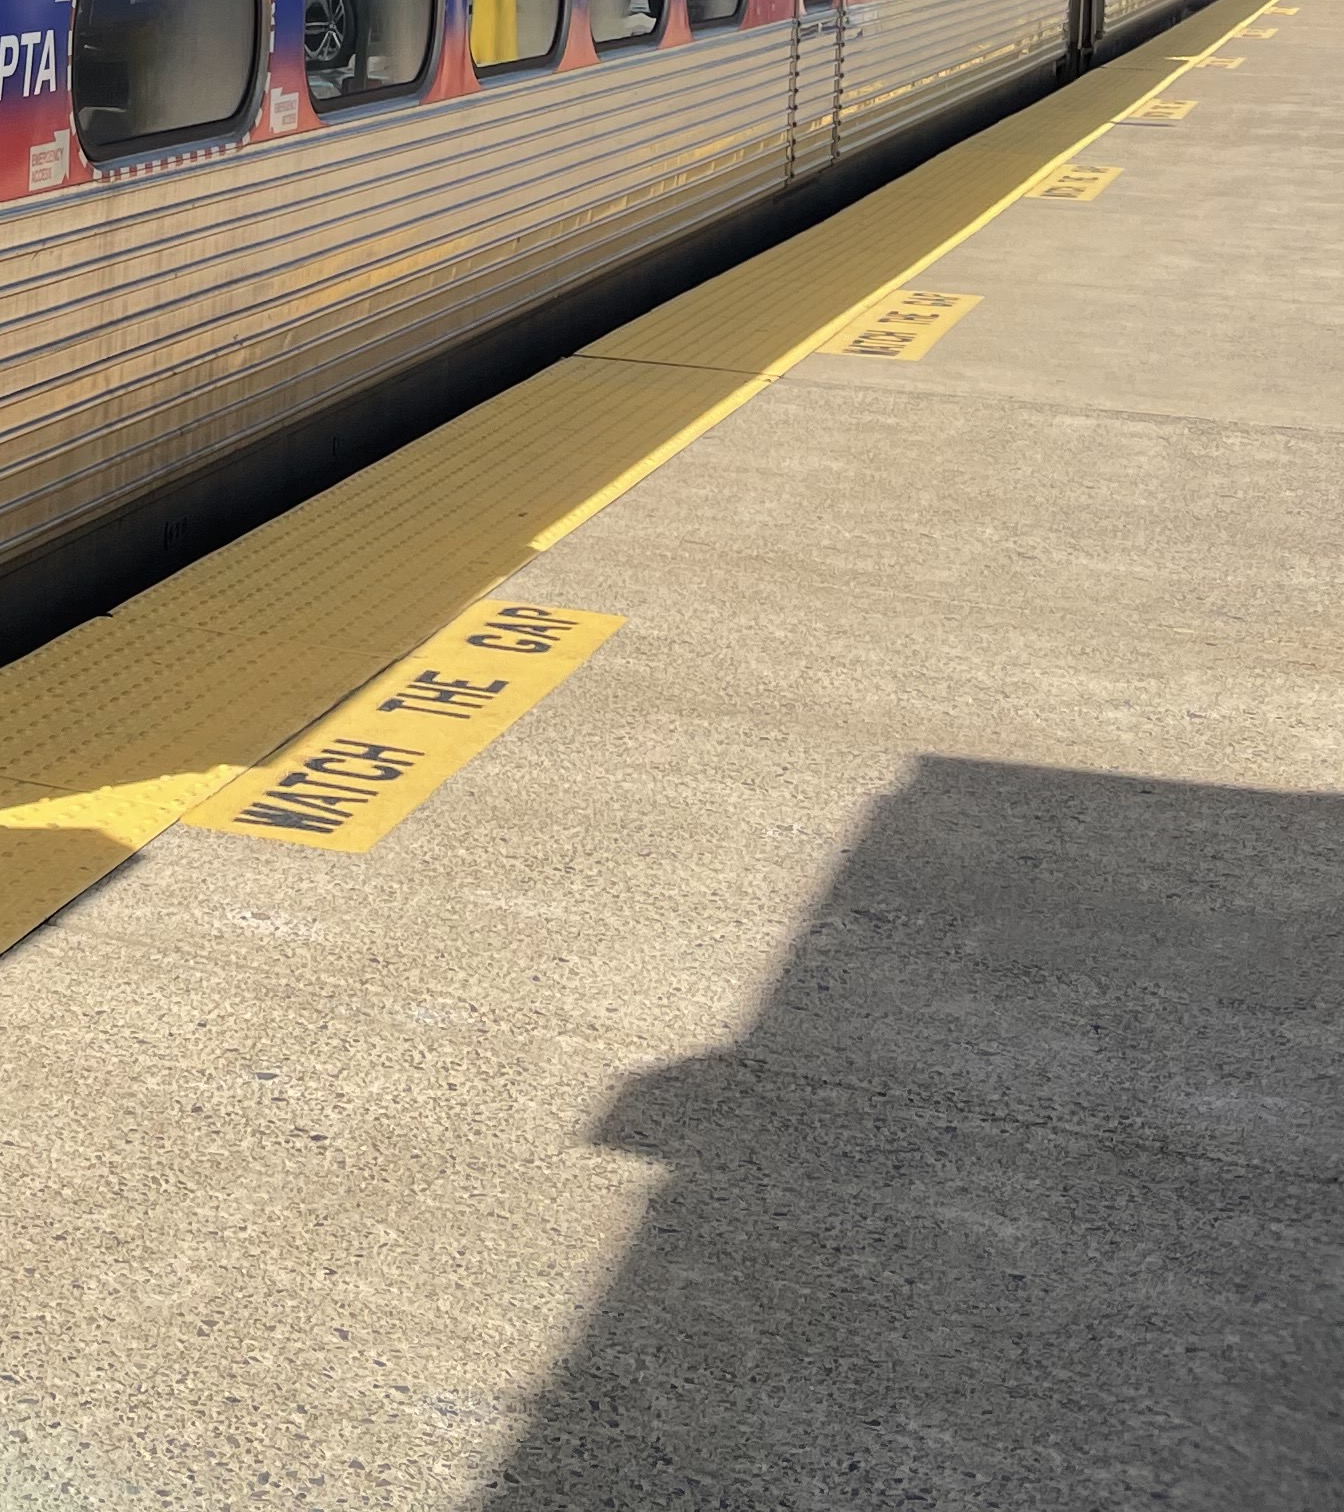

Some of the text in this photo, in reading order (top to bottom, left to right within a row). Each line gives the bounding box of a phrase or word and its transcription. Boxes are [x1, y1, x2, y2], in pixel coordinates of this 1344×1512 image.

[233, 606, 579, 834] WATCH THE GAP
